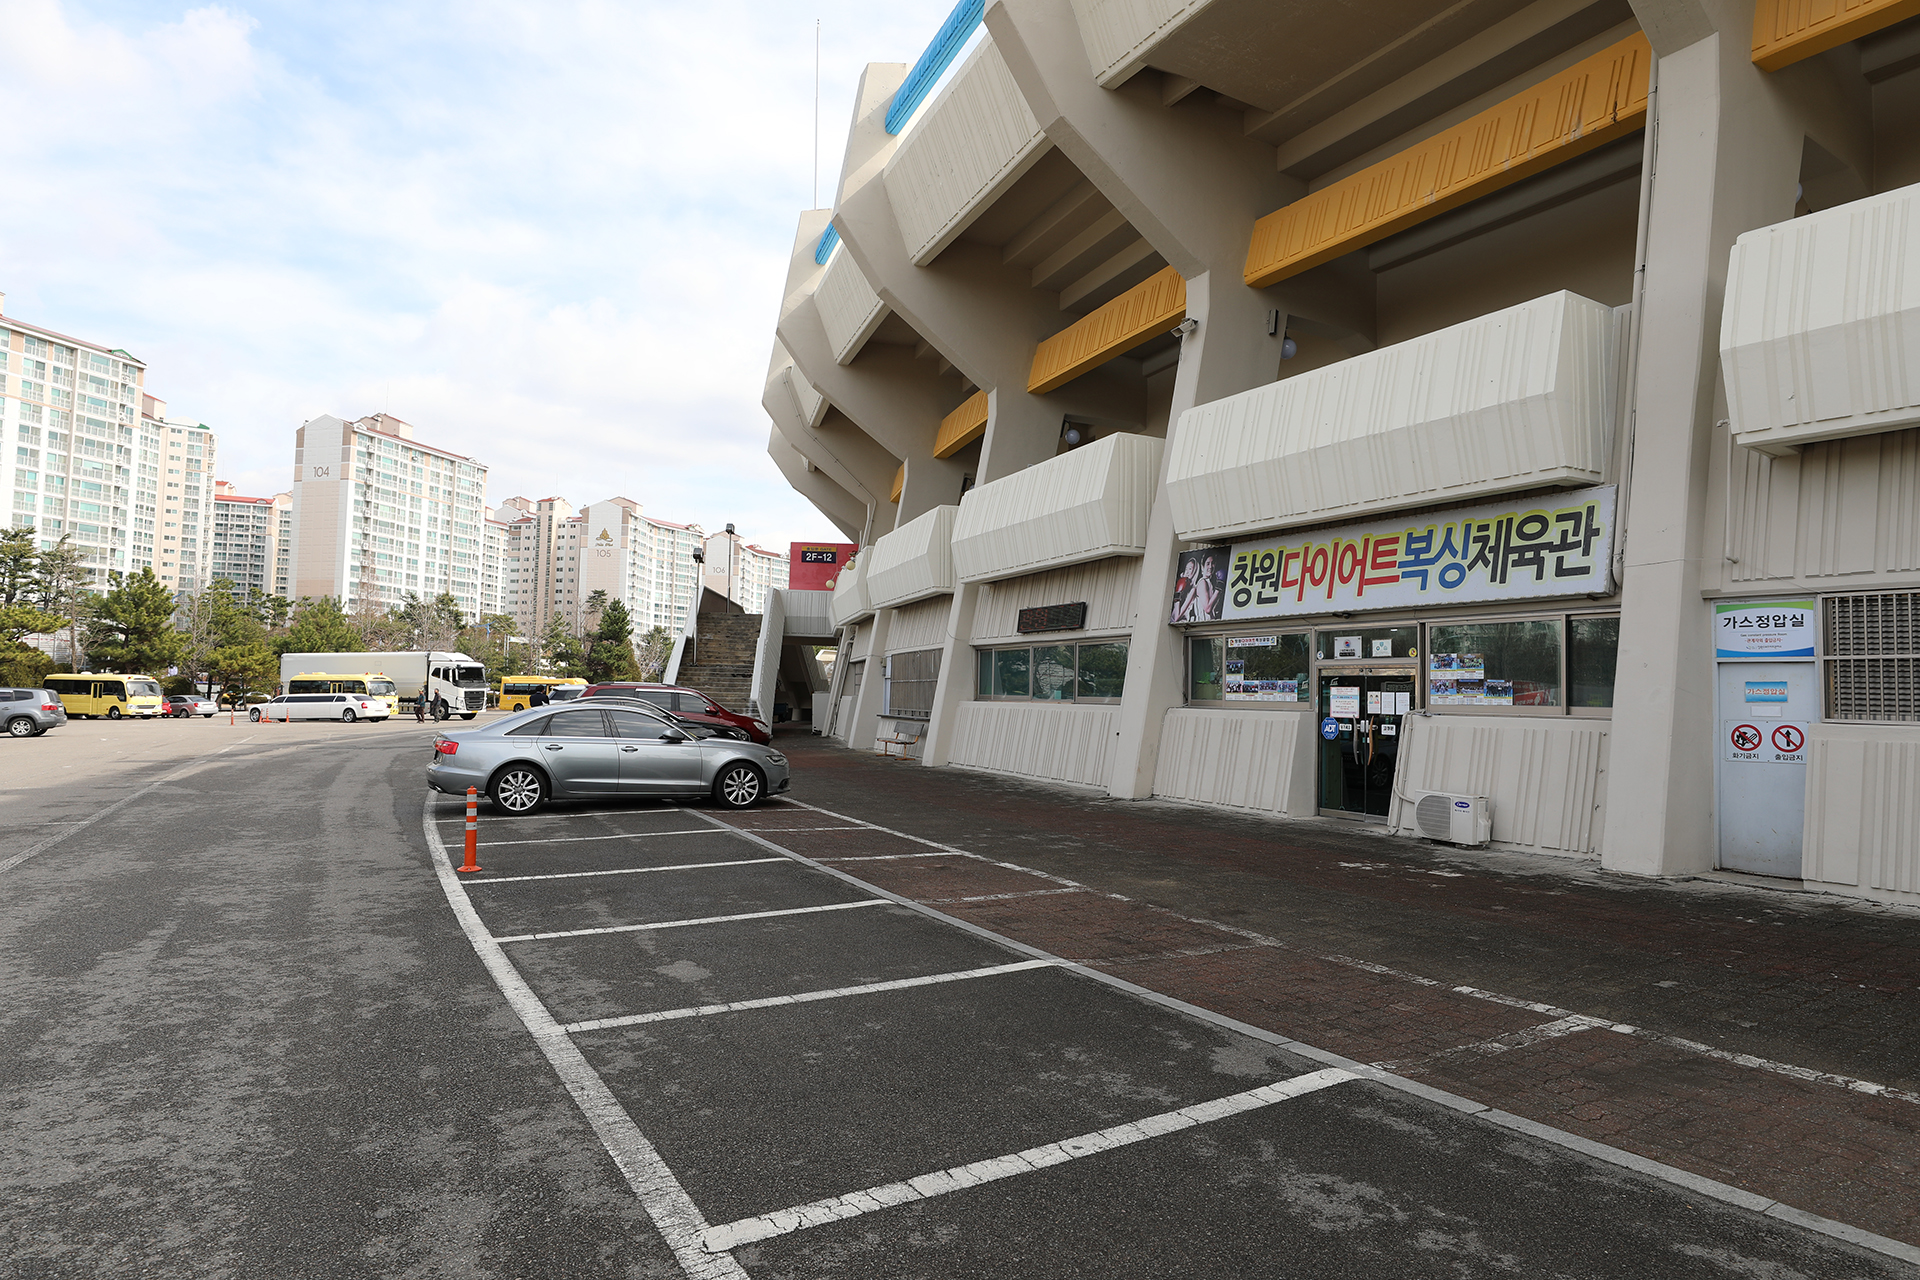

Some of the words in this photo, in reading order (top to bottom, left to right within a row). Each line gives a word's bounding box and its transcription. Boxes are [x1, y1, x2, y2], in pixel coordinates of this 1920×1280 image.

[313, 466, 330, 478] 104
[596, 549, 612, 558] 105
[806, 552, 833, 562] 2F-12
[713, 566, 726, 574] 106
[1723, 613, 1804, 630] 가스정압실
[1324, 724, 1336, 733] ADT
[1732, 752, 1759, 760] 화기금지
